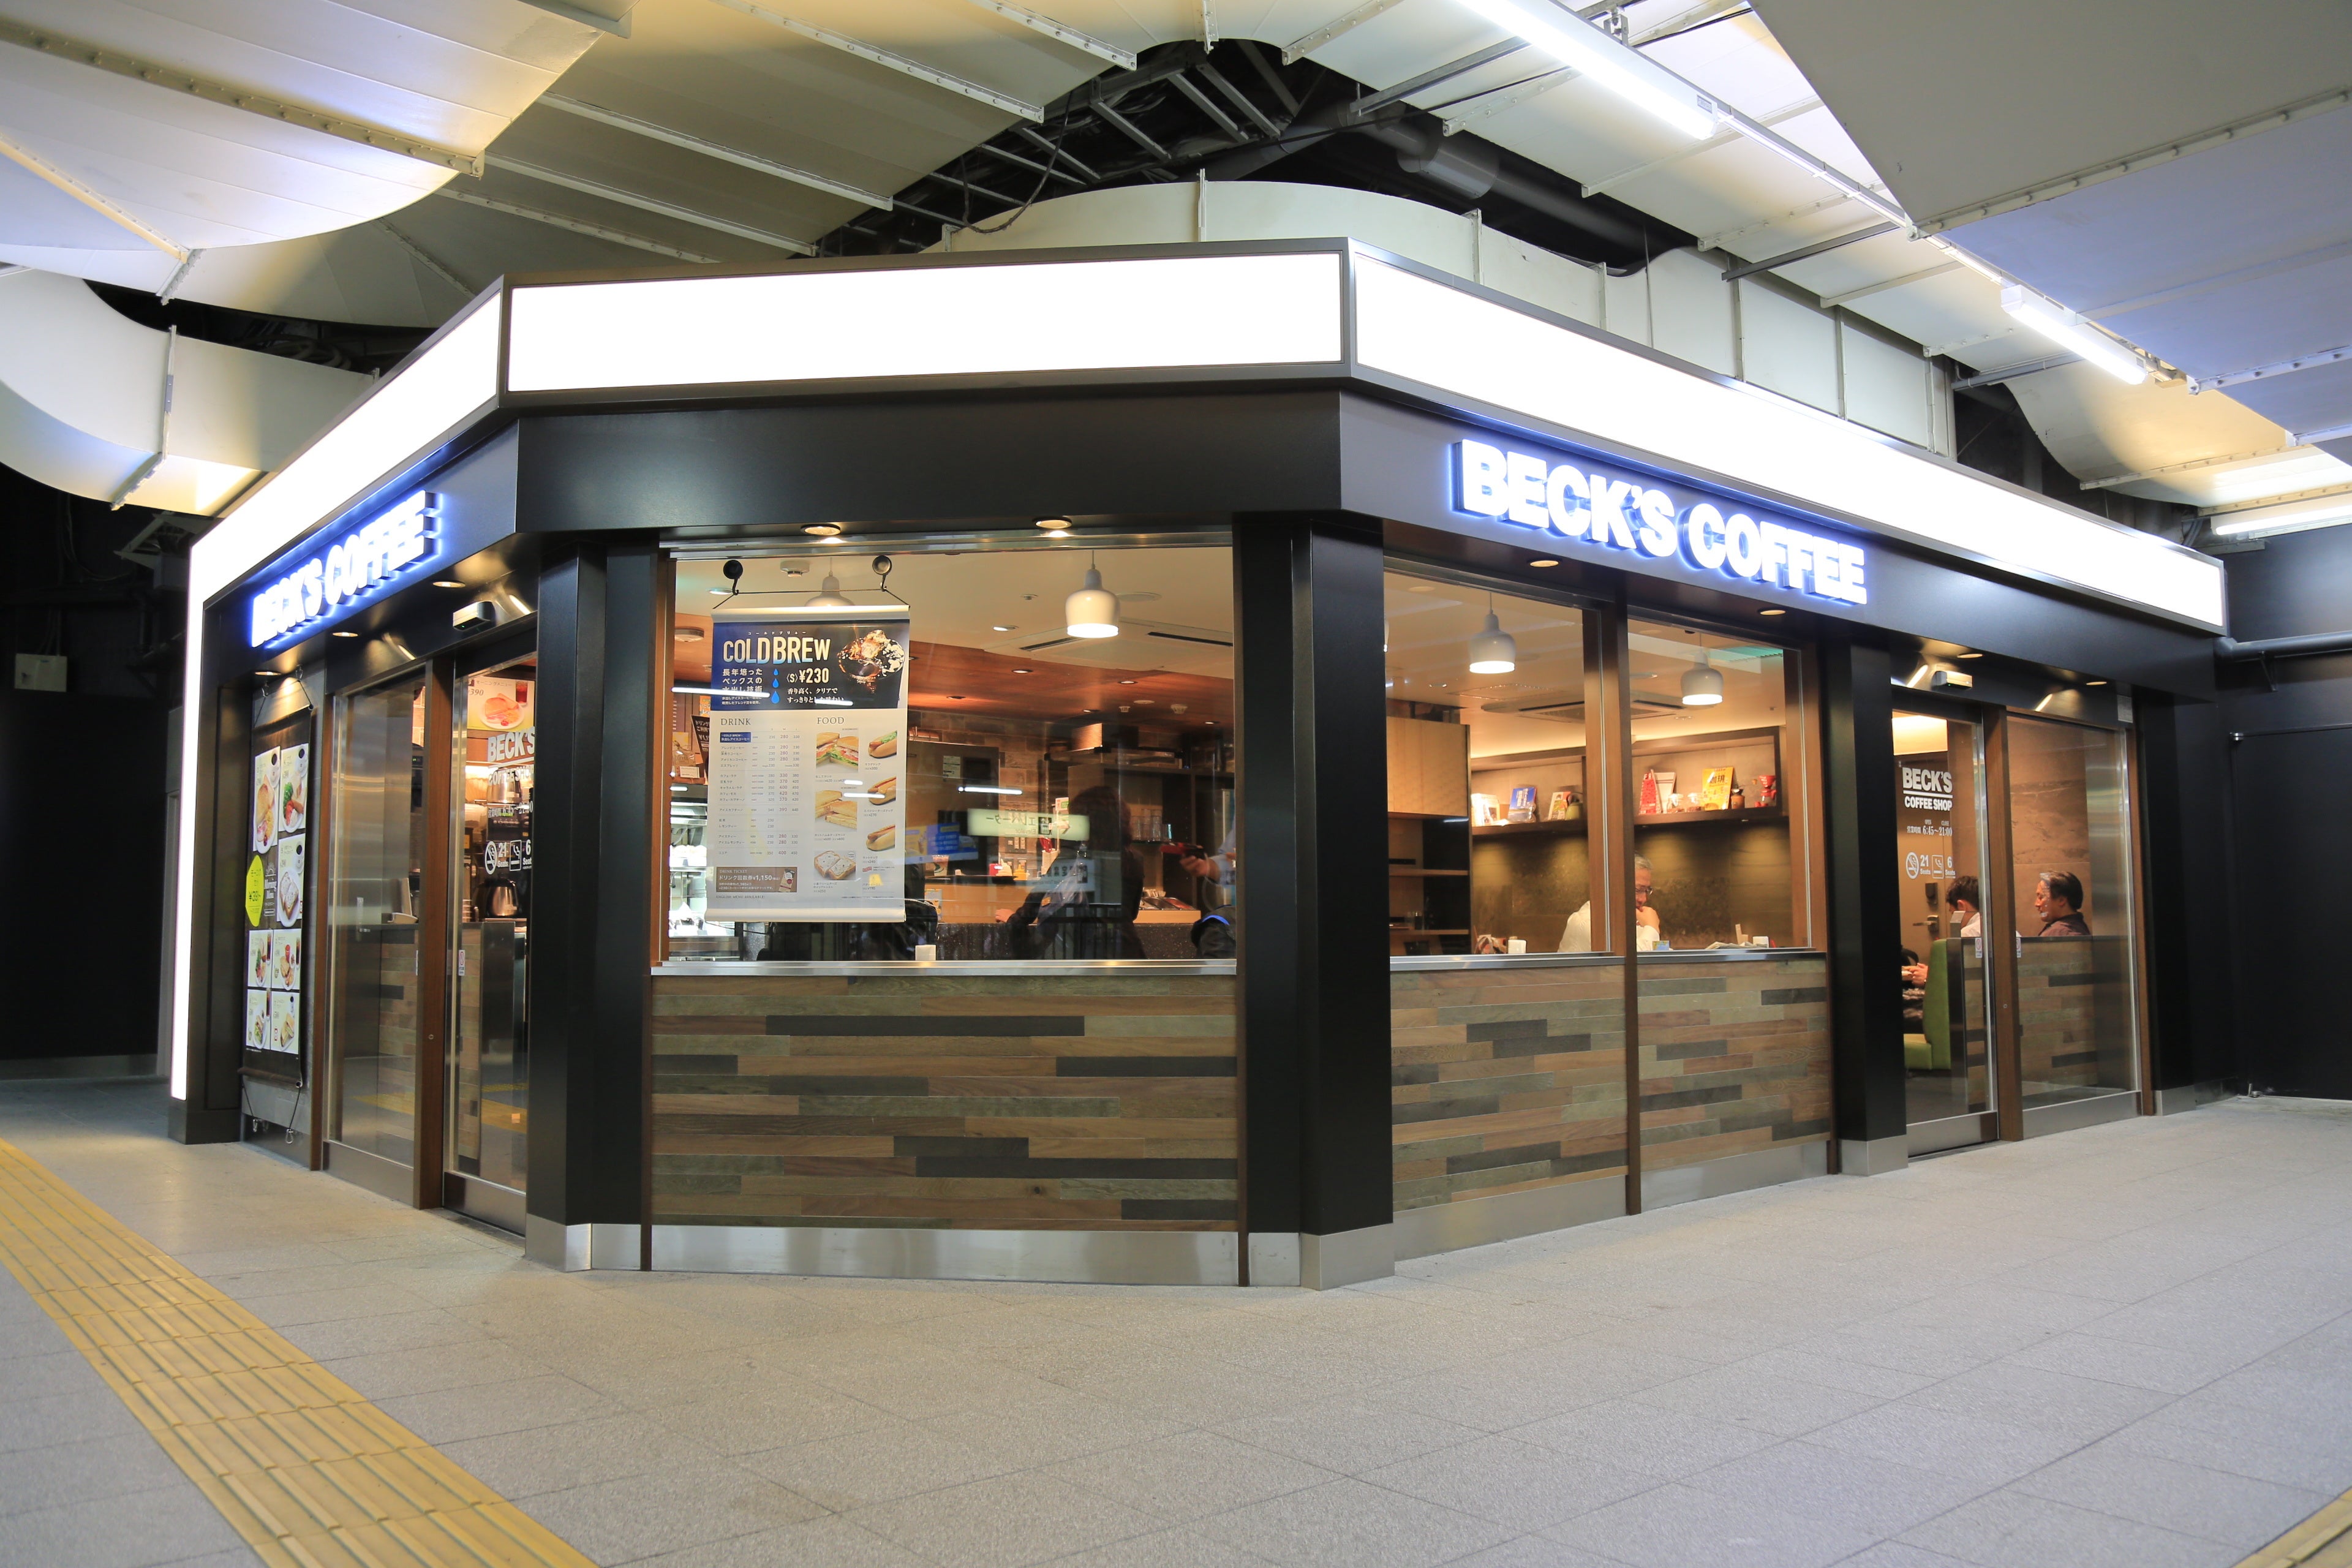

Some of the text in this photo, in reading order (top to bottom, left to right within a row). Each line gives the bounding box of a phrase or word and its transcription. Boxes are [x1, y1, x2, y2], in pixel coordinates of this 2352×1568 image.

[1461, 439, 1868, 605] BECK'S COFFEE
[325, 490, 426, 605] COFFEE
[799, 668, 829, 684] ¥230
[488, 726, 535, 763] BECK'S
[1902, 767, 1953, 794] BECK'S
[1904, 796, 1953, 812] COFFEE SHOP
[499, 839, 531, 858] 21 6
[1920, 854, 1952, 869] 21 6
